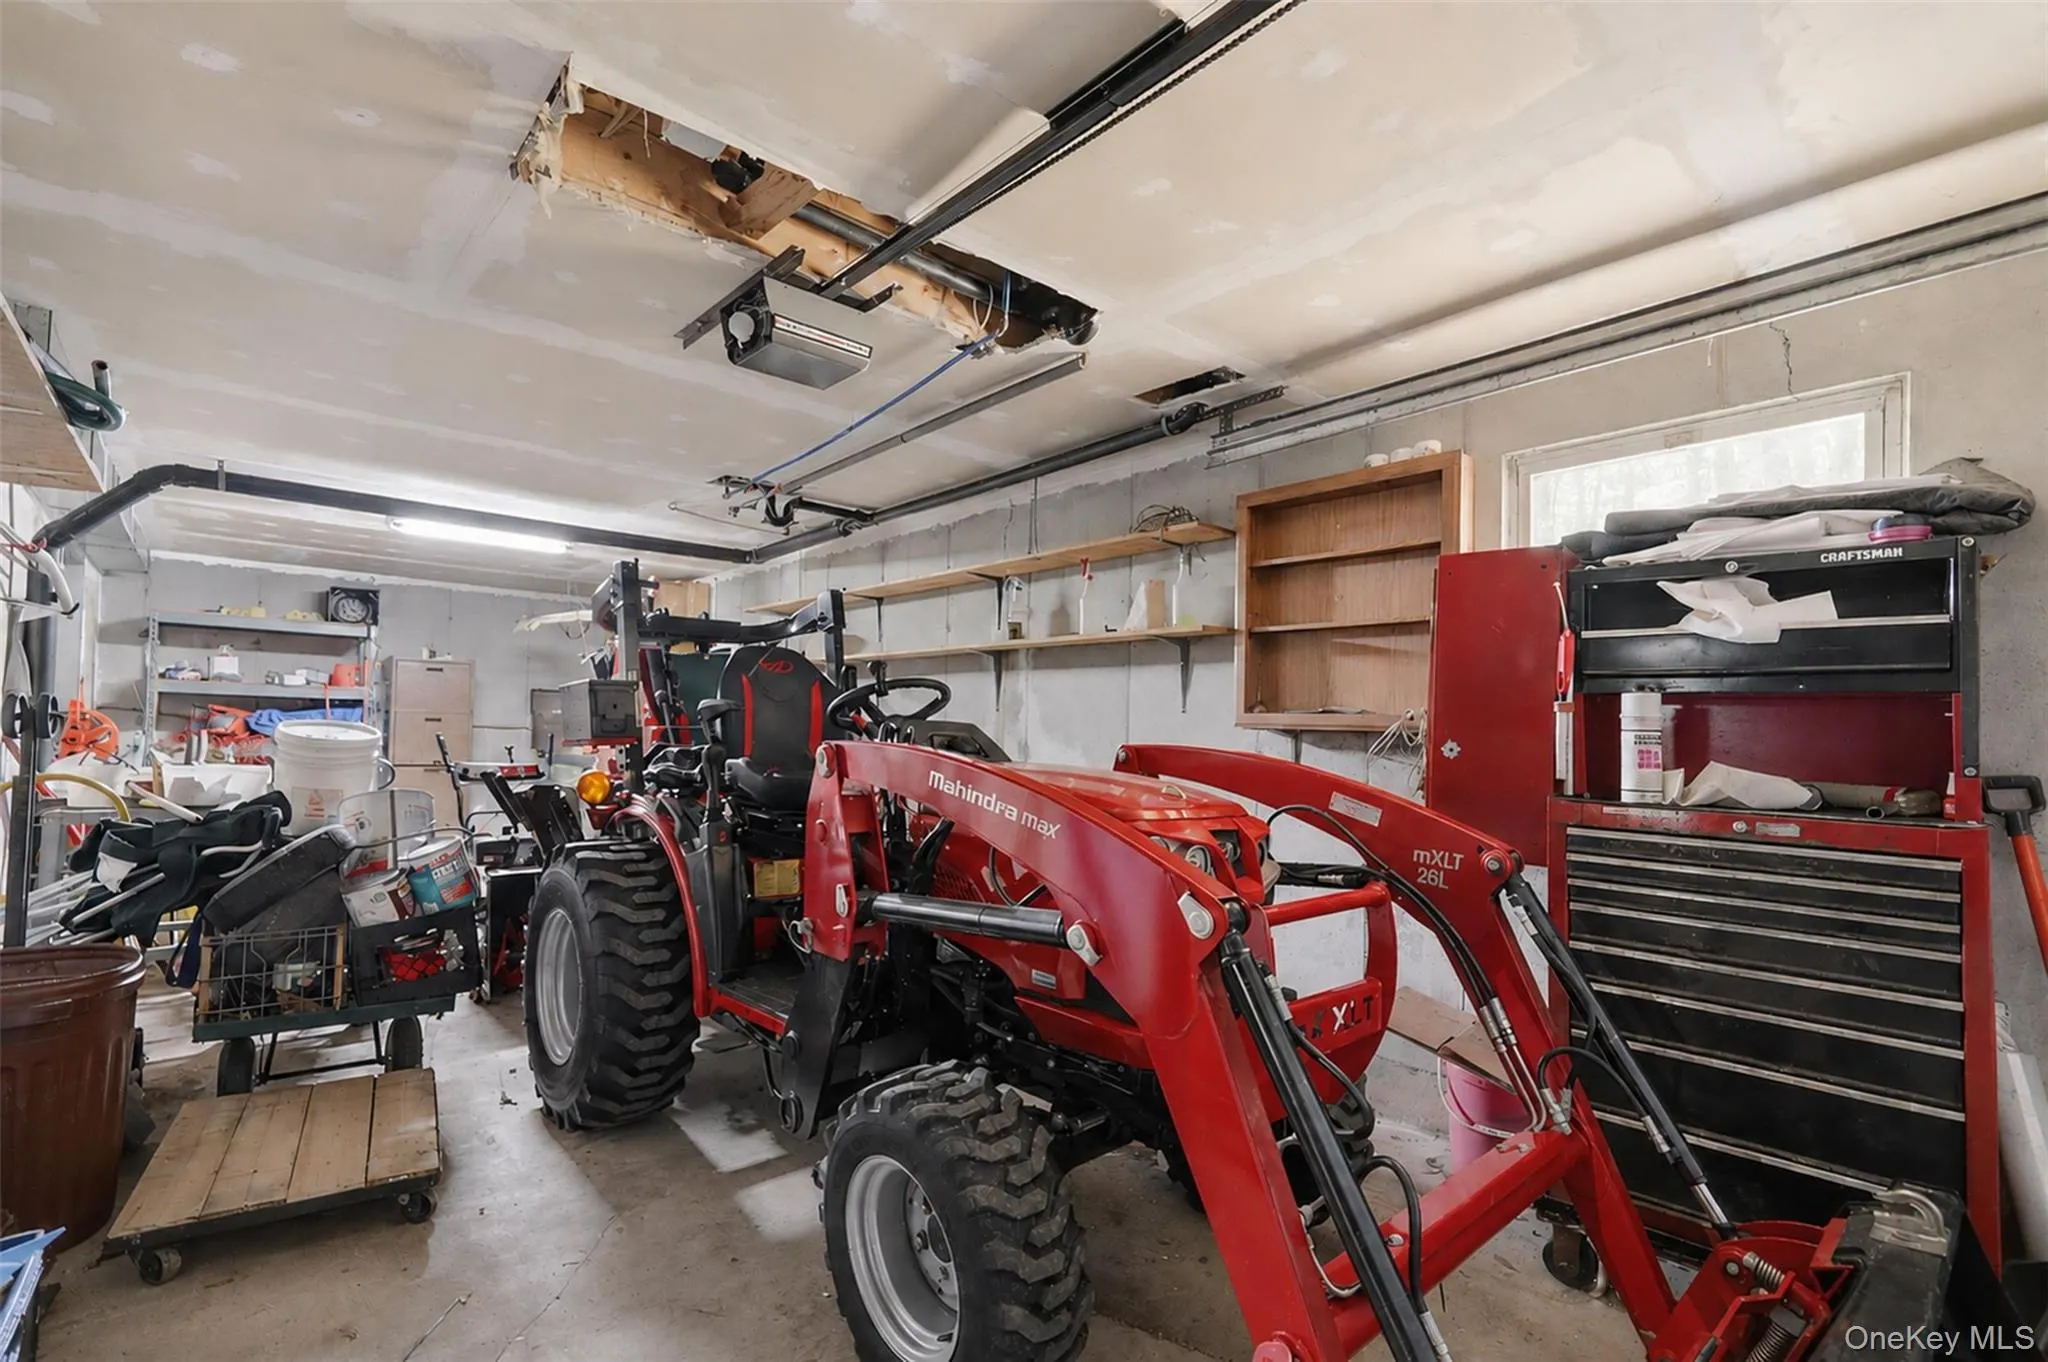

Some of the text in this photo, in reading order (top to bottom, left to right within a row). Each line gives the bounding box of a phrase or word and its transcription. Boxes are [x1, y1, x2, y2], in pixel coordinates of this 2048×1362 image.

[1820, 547, 1903, 563] CRAFTSMAN
[1020, 811, 1061, 839] max
[1412, 849, 1465, 871] mXLT
[1416, 867, 1449, 889] 26L
